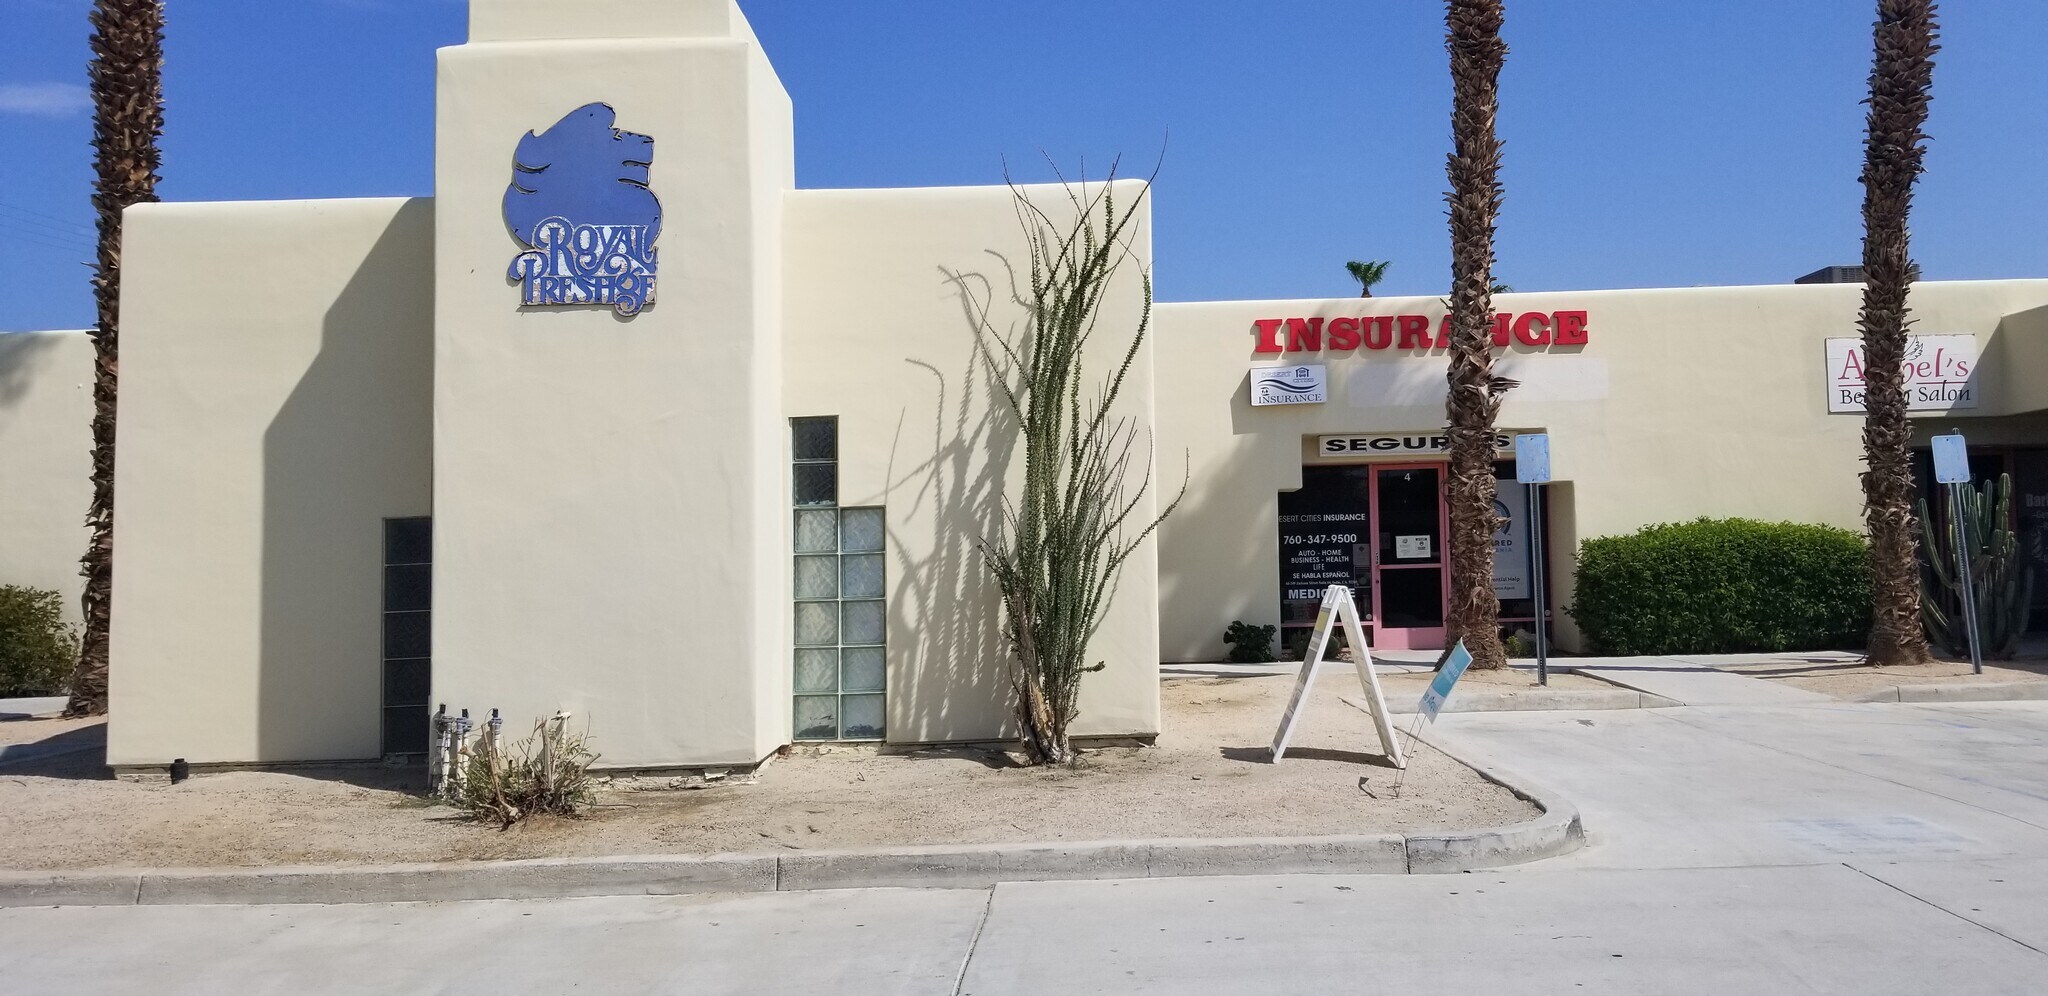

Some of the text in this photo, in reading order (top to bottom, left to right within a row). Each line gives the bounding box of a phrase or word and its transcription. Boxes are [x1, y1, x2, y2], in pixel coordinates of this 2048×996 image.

[532, 217, 657, 276] ROYAL
[508, 251, 657, 316] PRESTIGE
[1254, 311, 1589, 353] INSURNCE
[1918, 379, 1970, 402] Salon
[1258, 394, 1321, 404] INSURANCE
[1325, 434, 1511, 452] SEGURS
[1404, 472, 1411, 481] 4
[1278, 513, 1366, 523] ESERT CITIES INSURANCE
[1283, 534, 1357, 544] 760-347-9500
[1298, 549, 1316, 557] AUTO
[1325, 555, 1349, 563] HEALTH
[1288, 587, 1356, 600] MEDICE
